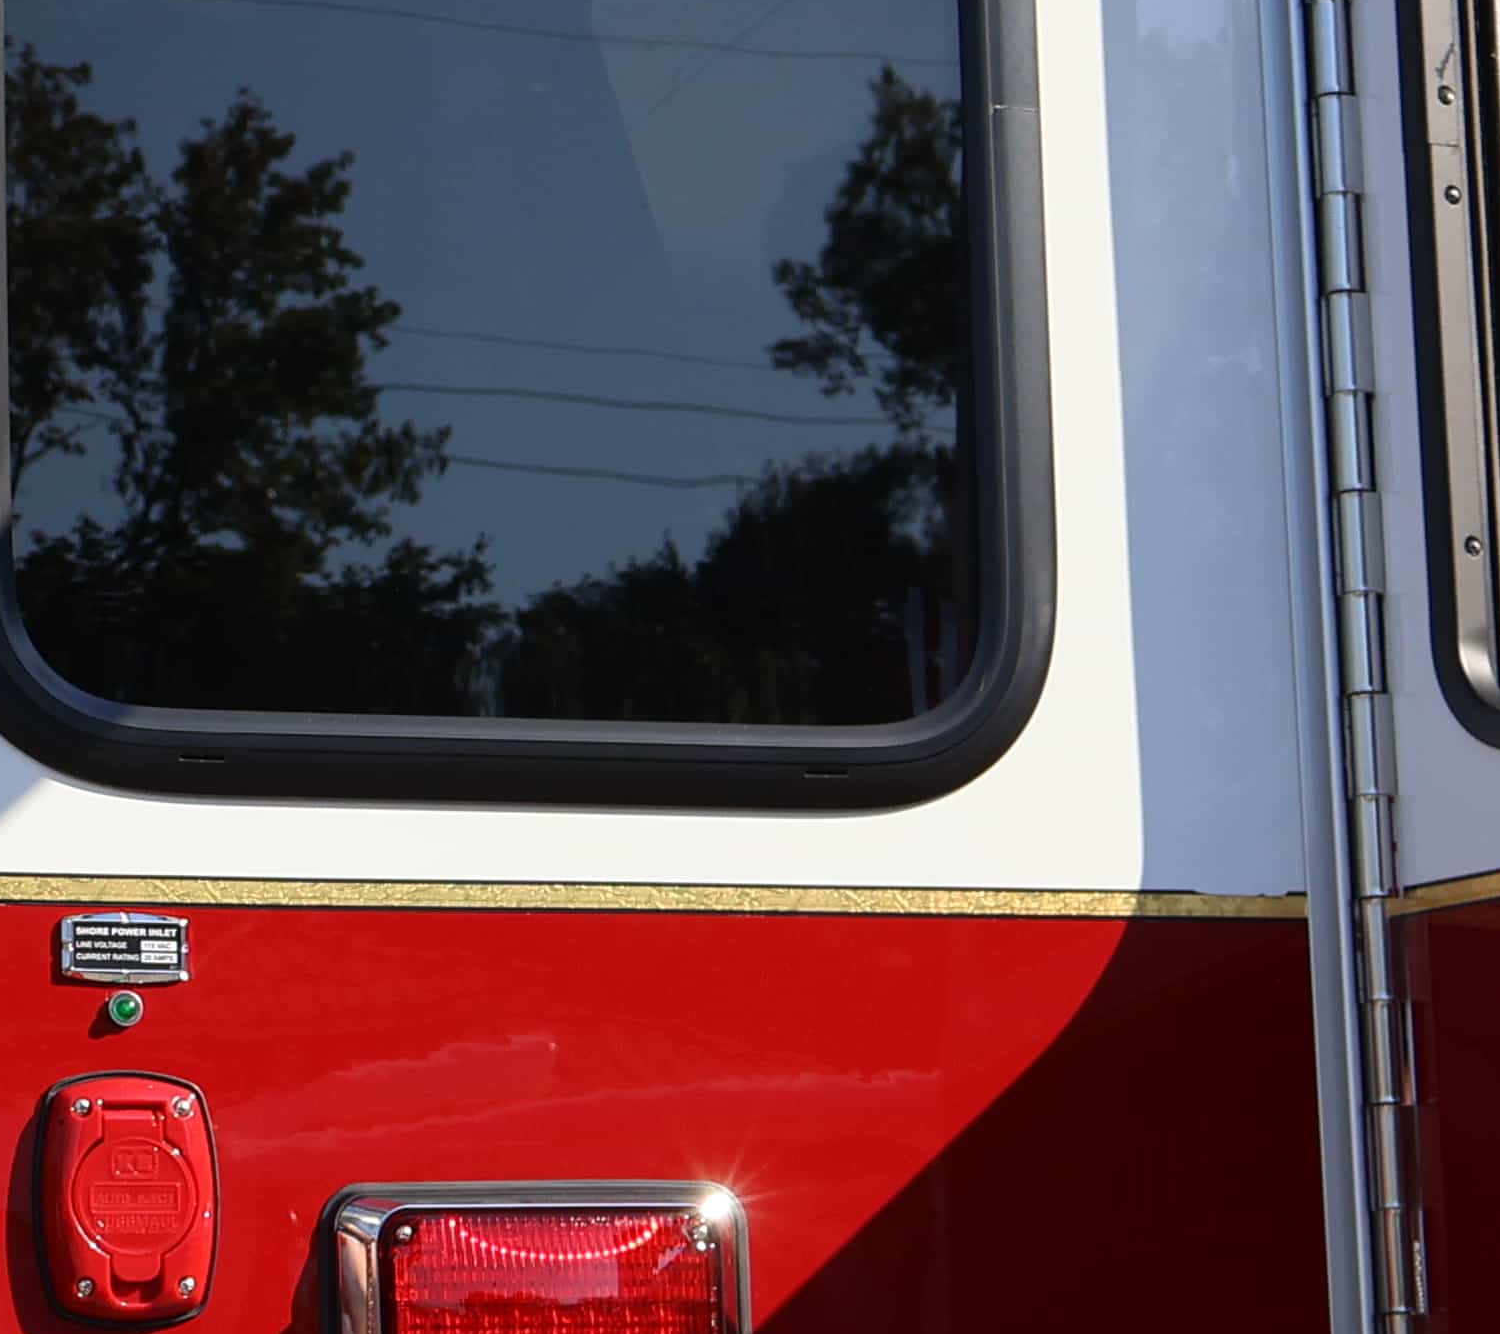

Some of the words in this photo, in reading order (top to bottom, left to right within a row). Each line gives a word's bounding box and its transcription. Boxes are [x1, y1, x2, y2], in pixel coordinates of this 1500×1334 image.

[75, 926, 109, 936] SHORE
[111, 927, 146, 937] POWER
[148, 928, 177, 937] INLET
[75, 940, 92, 949] LINE
[94, 940, 128, 950] VOLTAGE
[75, 952, 111, 961] CURRENT
[112, 952, 140, 962] RATING
